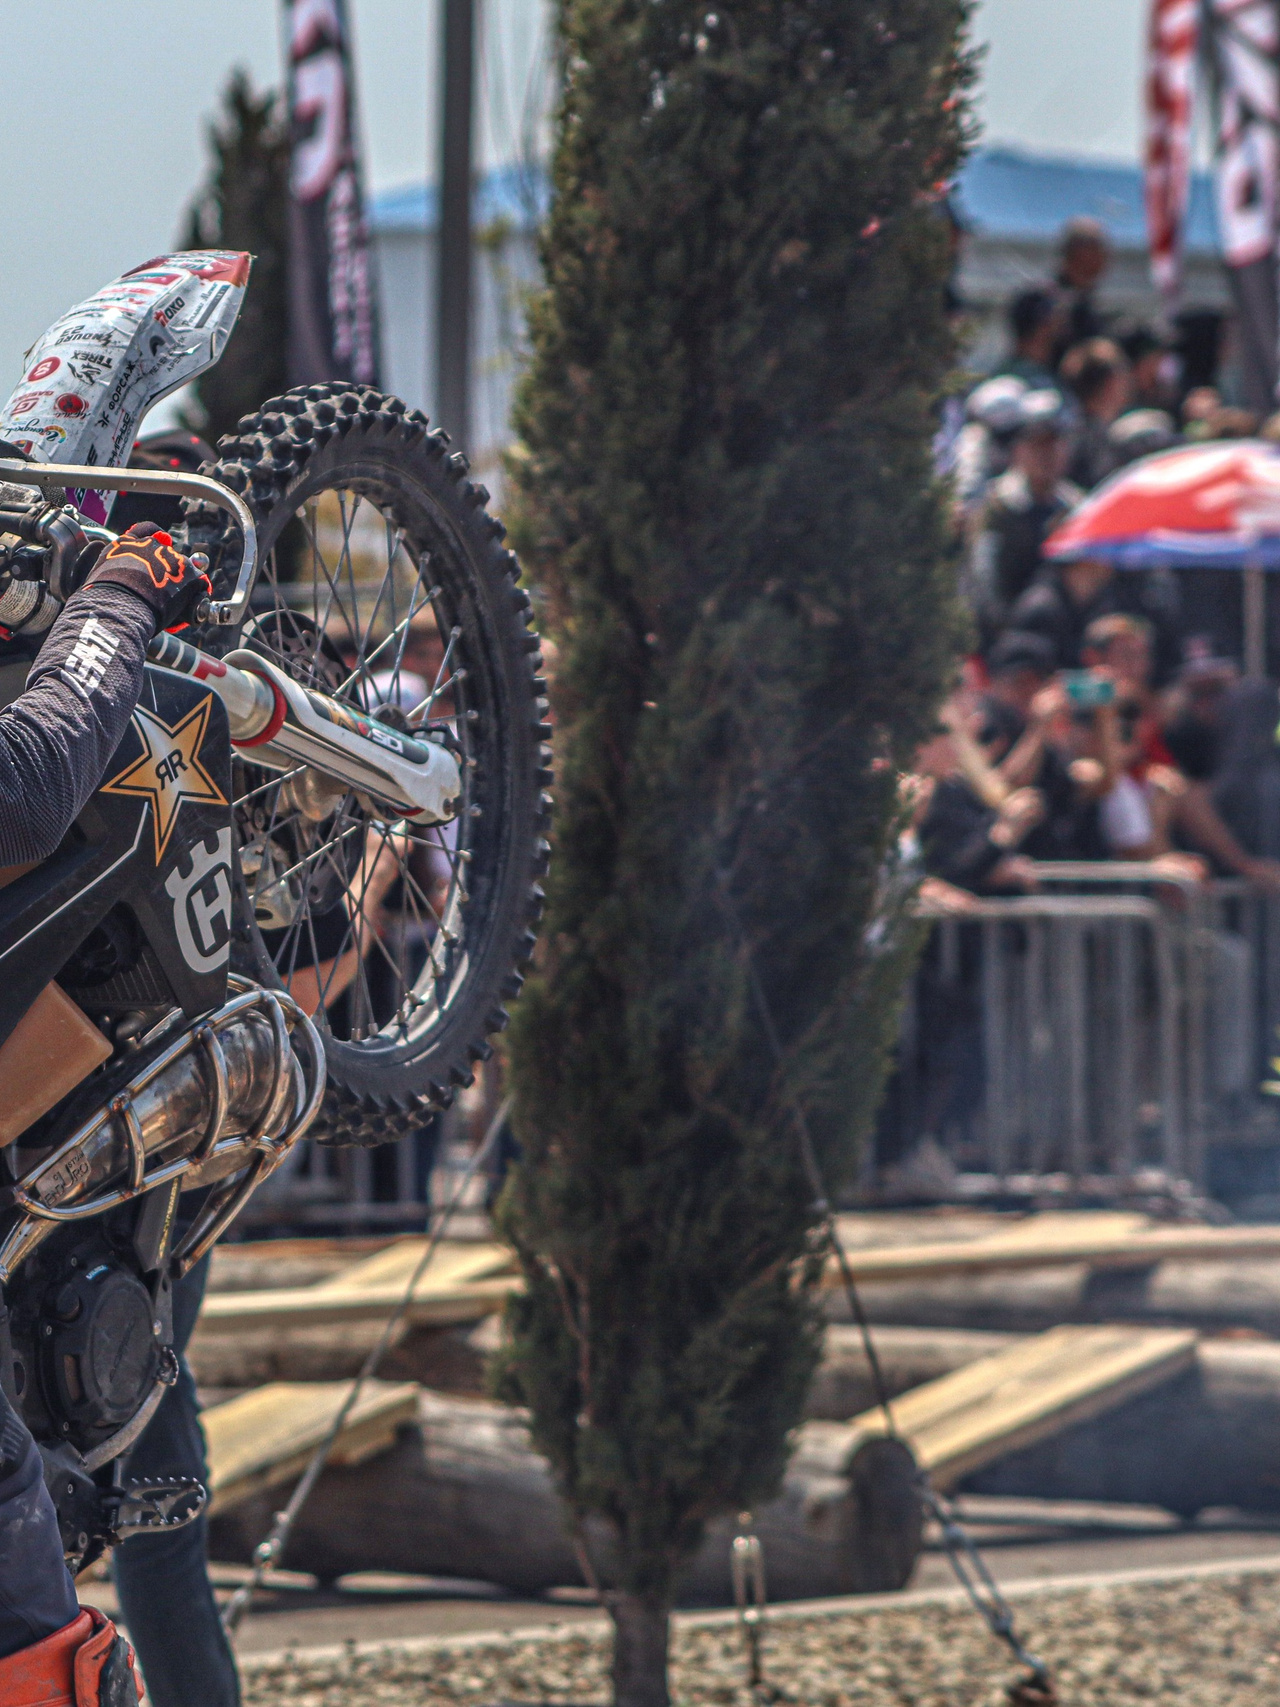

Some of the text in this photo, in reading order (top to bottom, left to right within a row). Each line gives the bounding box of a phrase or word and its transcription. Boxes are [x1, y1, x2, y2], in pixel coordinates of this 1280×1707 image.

[71, 350, 112, 369] TIREX
[108, 361, 136, 410] ФОРСАЖ
[43, 1160, 91, 1206] ENDURO
